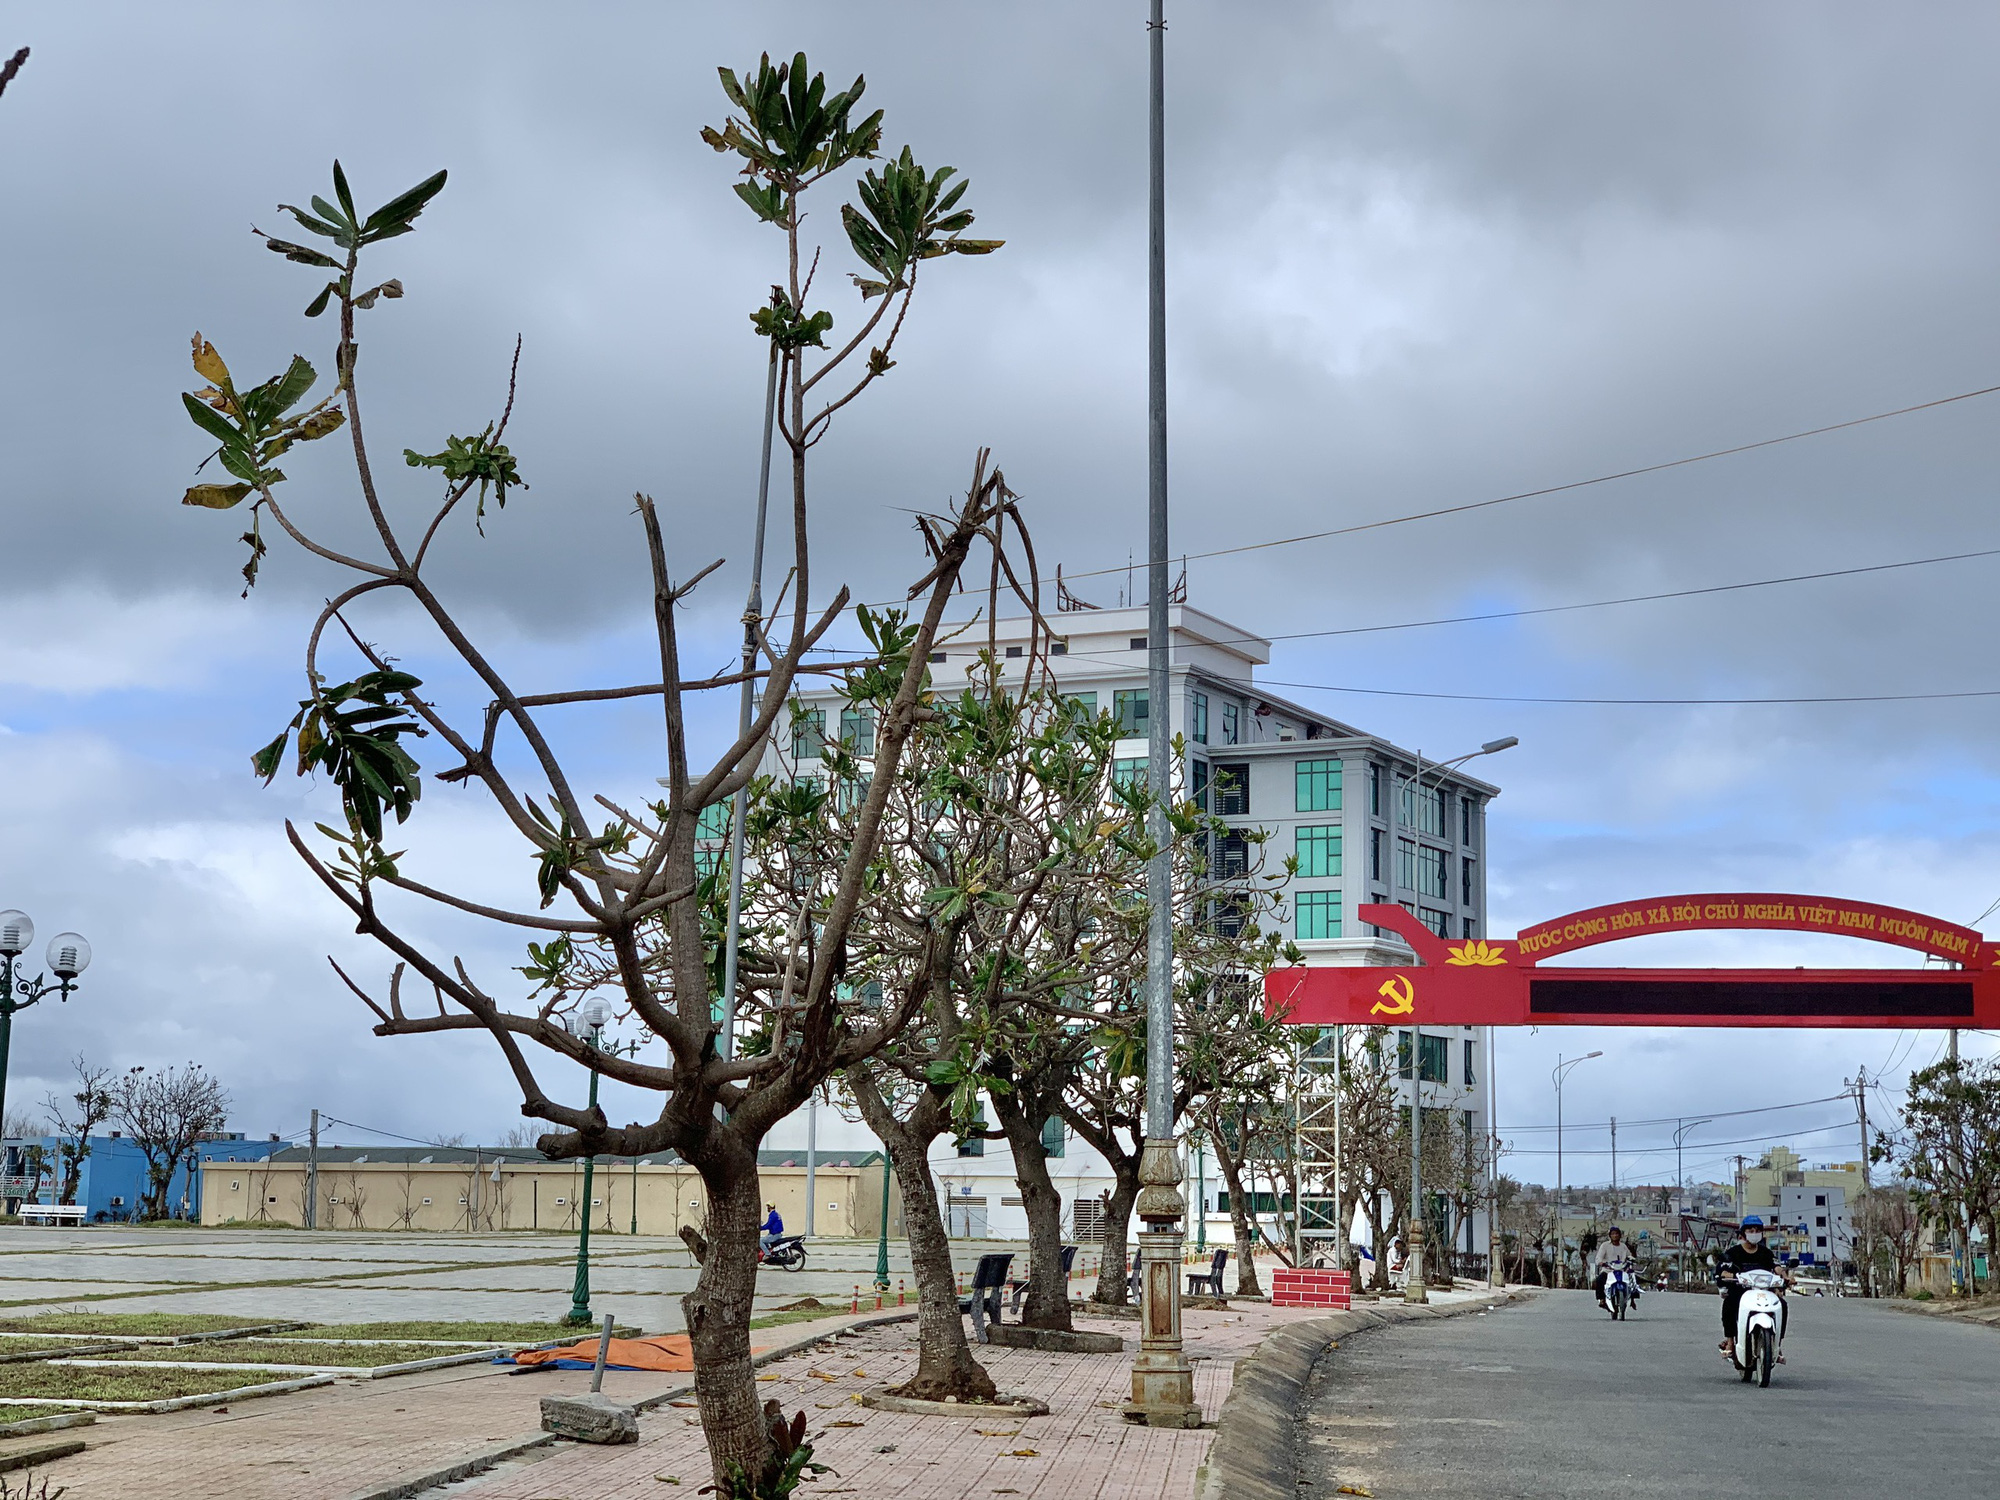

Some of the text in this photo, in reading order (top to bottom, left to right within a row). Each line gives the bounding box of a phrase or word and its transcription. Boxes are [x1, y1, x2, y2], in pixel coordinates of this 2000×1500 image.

[1517, 928, 1563, 955] NƯỚC
[1564, 918, 1608, 940] CỘNG
[1610, 908, 1646, 931] HÒA
[1647, 905, 1671, 925] XÃ
[1672, 901, 1702, 924] HỘI
[1704, 899, 1739, 920] CHỦ
[1743, 902, 1796, 921] NGHĨA
[1797, 904, 1837, 926] VIỆT
[1838, 910, 1876, 930] NAM
[1878, 917, 1929, 941] MUÔN
[1929, 931, 1970, 955] NĂM
